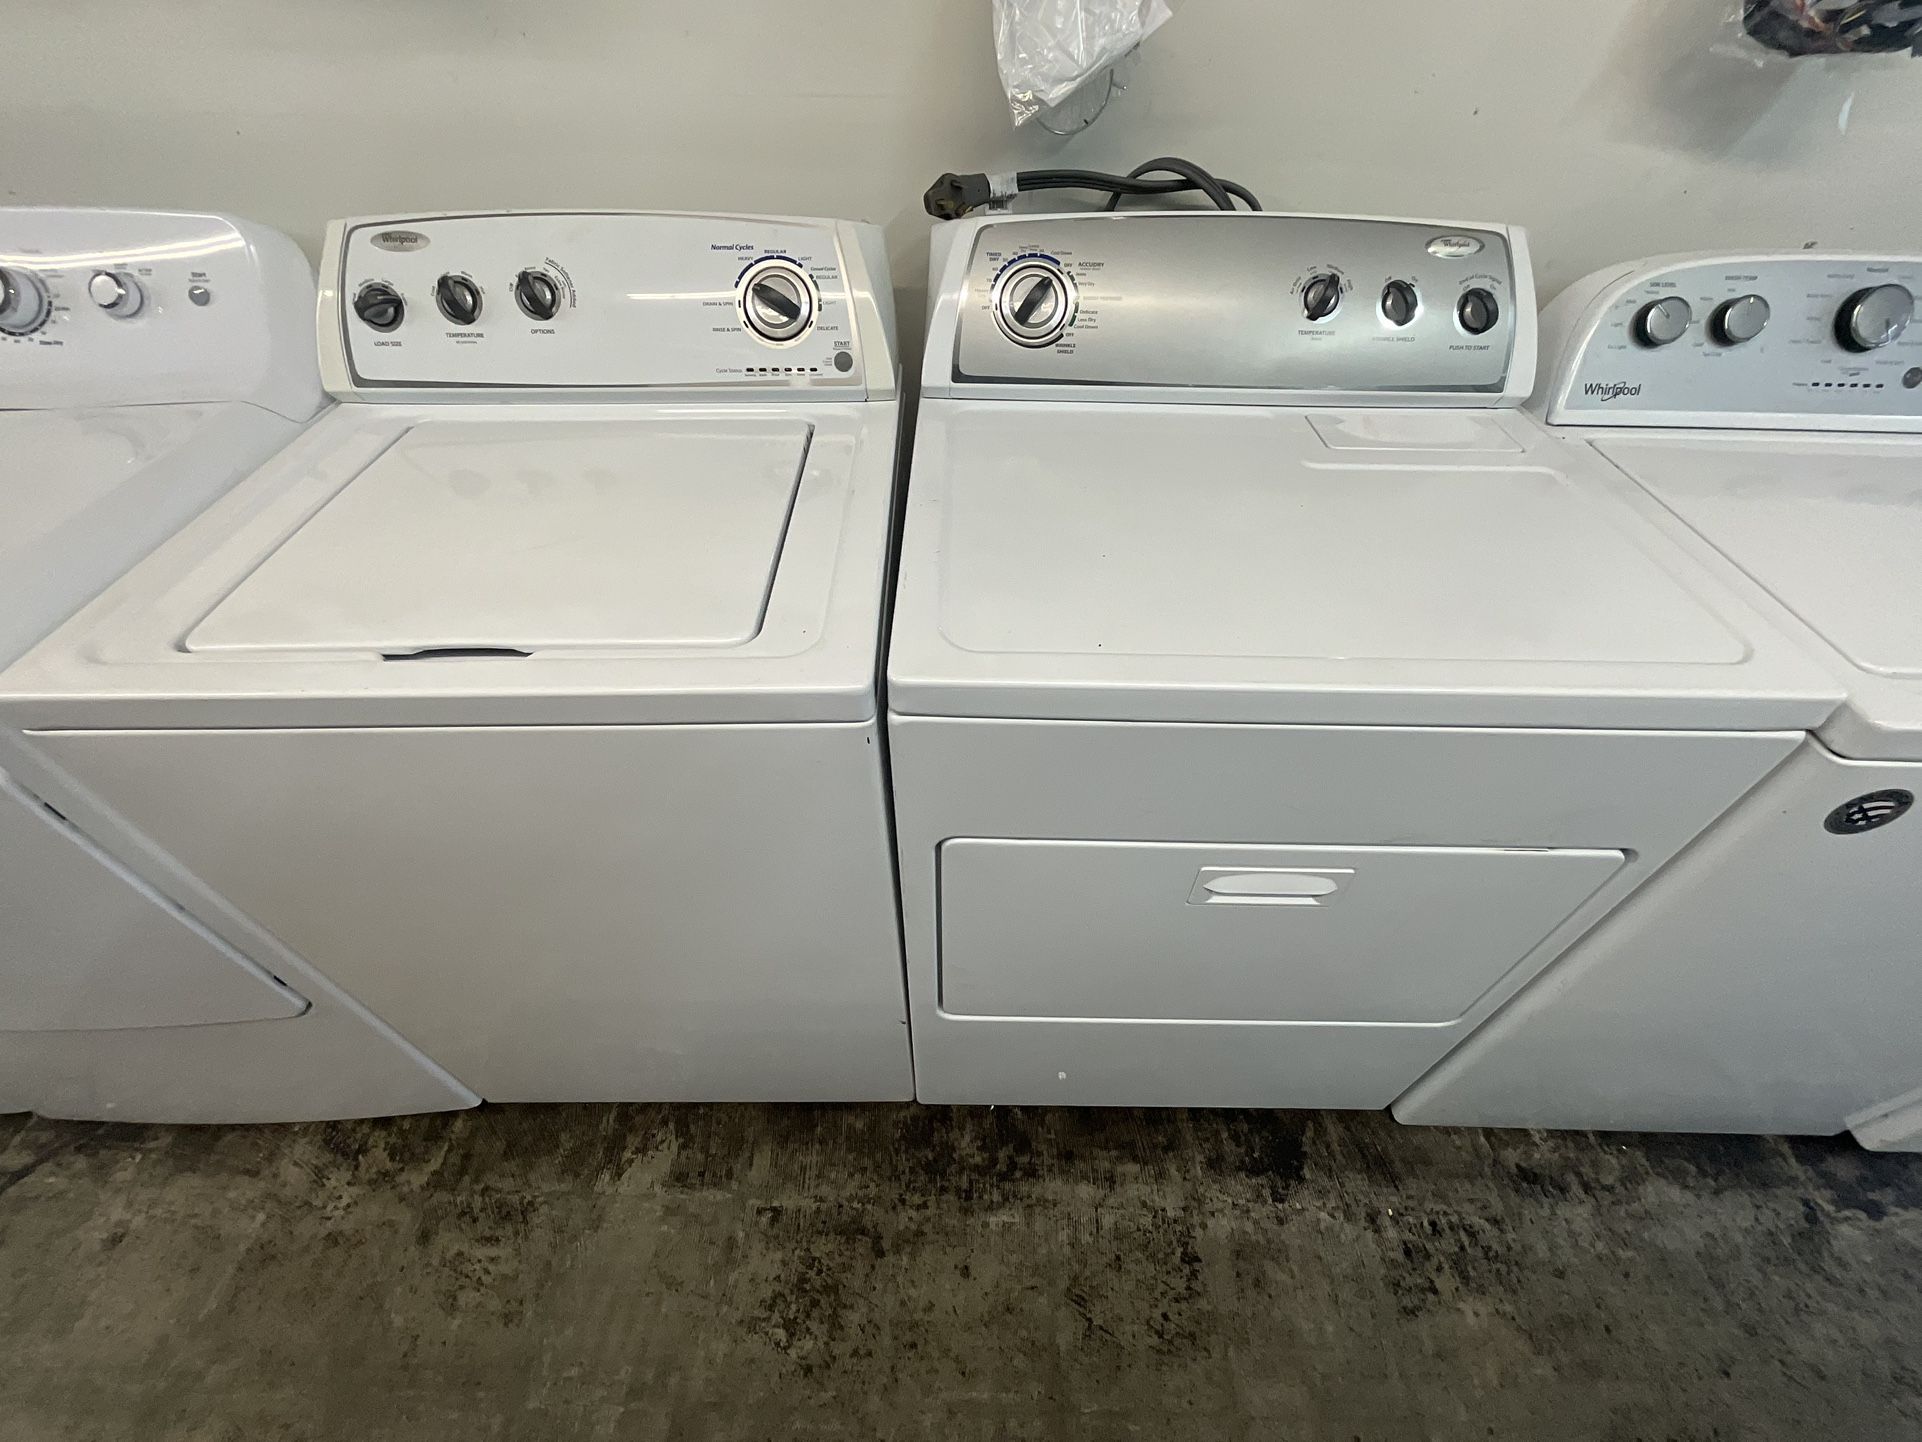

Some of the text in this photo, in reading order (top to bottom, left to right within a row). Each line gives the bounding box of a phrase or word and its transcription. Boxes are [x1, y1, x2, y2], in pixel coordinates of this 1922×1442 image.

[381, 232, 419, 246] Whirlpool
[710, 243, 755, 252] Normal Cycles
[1584, 381, 1642, 401] Whirlpool
